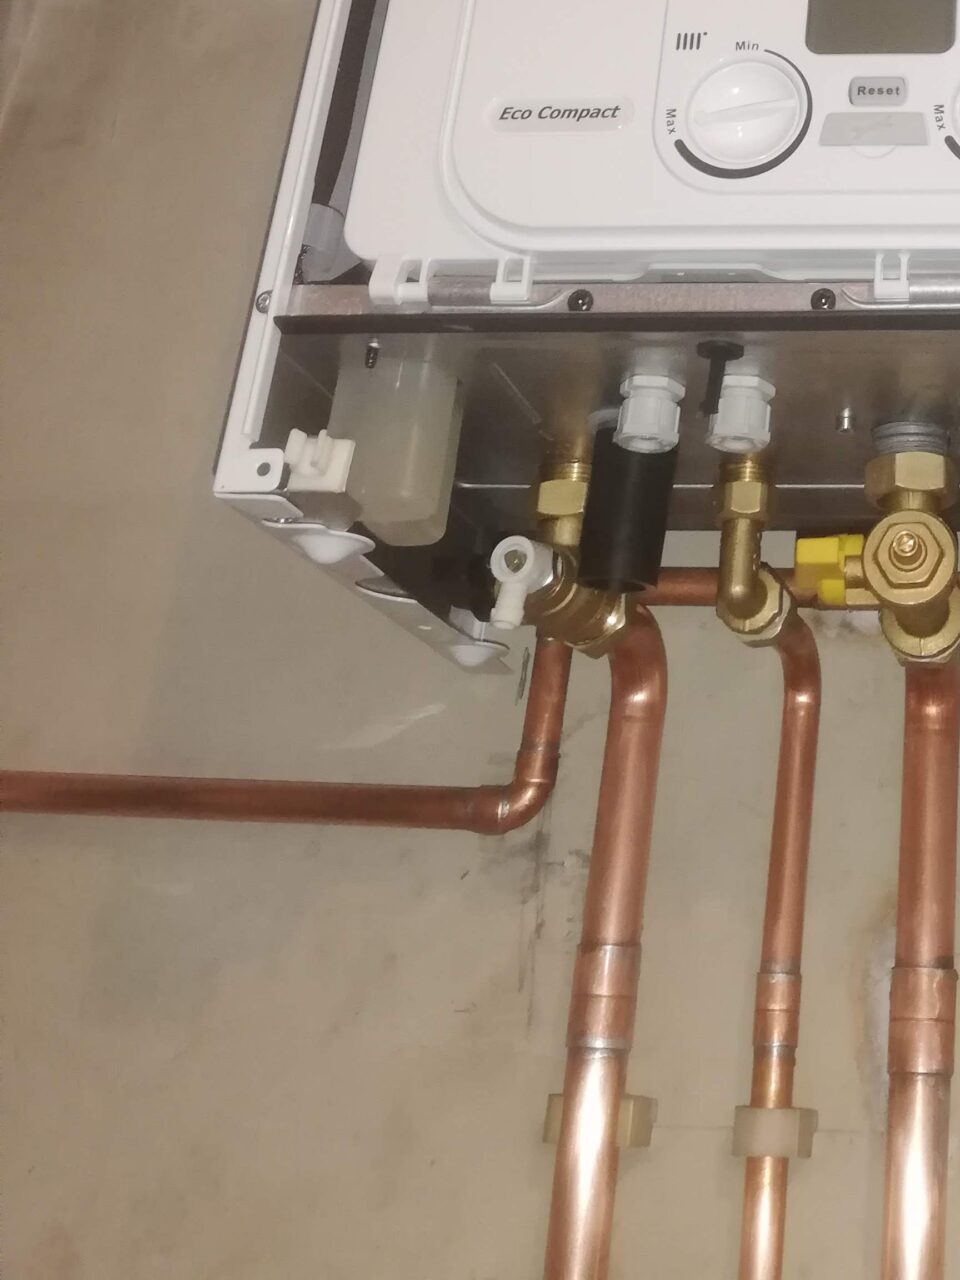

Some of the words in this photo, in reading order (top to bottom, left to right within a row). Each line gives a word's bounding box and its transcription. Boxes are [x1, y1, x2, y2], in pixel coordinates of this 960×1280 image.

[735, 40, 759, 51] Min
[857, 85, 900, 96] Reset
[499, 106, 533, 121] Eco
[537, 105, 621, 122] Compact
[665, 108, 677, 135] Max
[933, 104, 946, 131] Max
